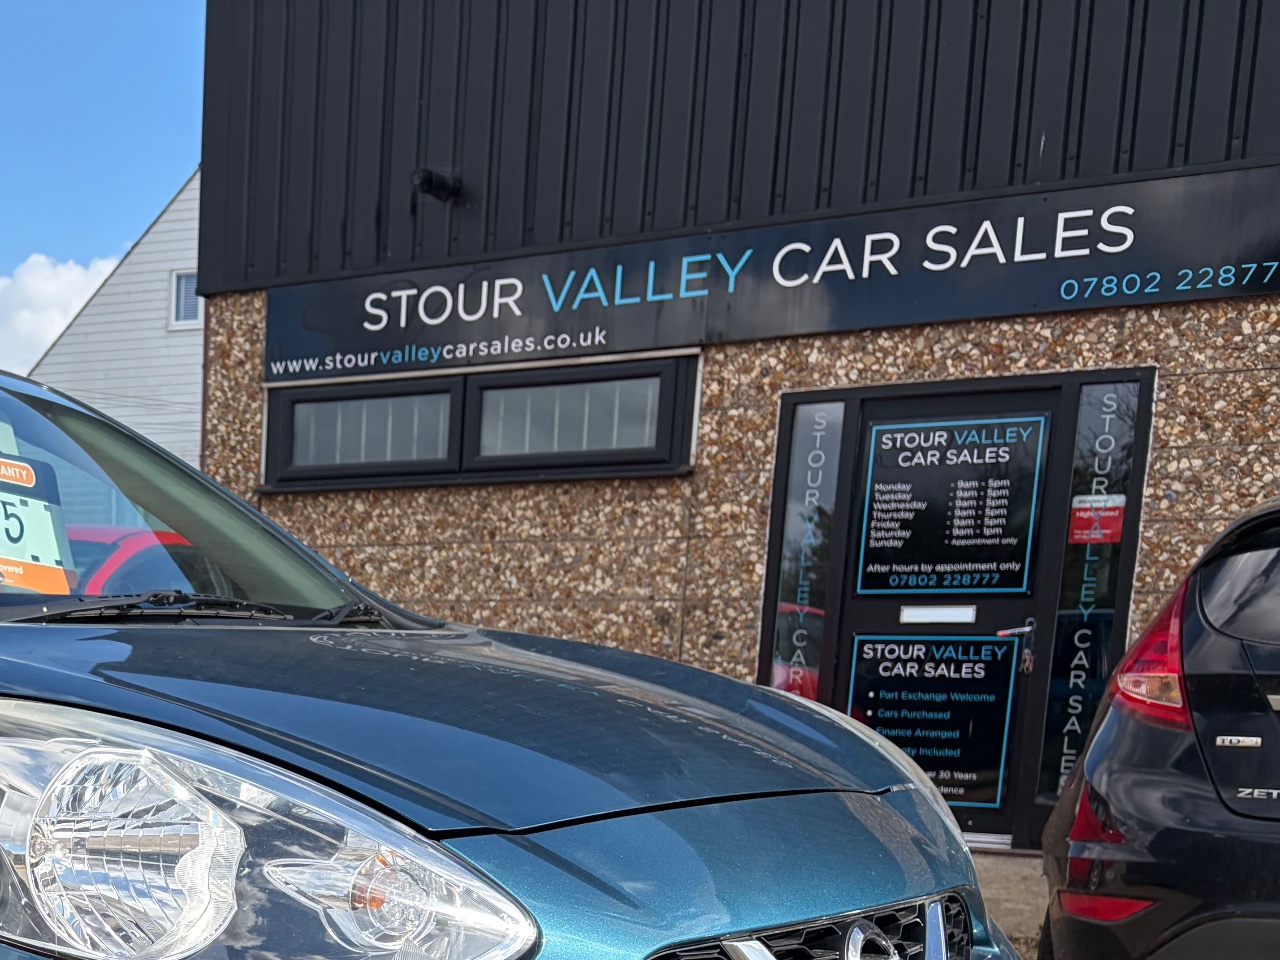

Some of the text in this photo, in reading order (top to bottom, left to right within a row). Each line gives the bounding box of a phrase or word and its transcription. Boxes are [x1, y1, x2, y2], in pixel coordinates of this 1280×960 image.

[362, 205, 1136, 331] STOUR VALLEY CAR SALES
[1060, 271, 1162, 300] 07802
[271, 325, 607, 375] www.stourvalleycarsales.co.uk
[881, 427, 1032, 449] STOUR VALLEY
[1091, 393, 1117, 495] STOUR
[804, 412, 826, 507] STOUR
[898, 447, 1010, 467] CAR SALES
[874, 482, 912, 492] Monday
[874, 492, 912, 501] Tuesday
[873, 501, 928, 511] Wednesday
[872, 510, 915, 520] Thursday
[871, 520, 901, 529] Friday
[870, 529, 912, 539] Saturday
[869, 539, 904, 548] Sunday
[795, 514, 818, 624] VALLEY
[866, 560, 1021, 573] After hours by appointment only
[889, 573, 1000, 586] 07802 228777
[789, 629, 808, 685] CAR
[863, 644, 1007, 661] STOUR VALLEY
[1069, 629, 1092, 689] CAR
[879, 662, 986, 679] CAR SALES
[879, 690, 995, 702] Part Exchange Welcome
[878, 708, 950, 720] Cars Purchased
[876, 727, 960, 739] Finance Arranged
[919, 747, 960, 758] Included
[953, 771, 977, 781] Years
